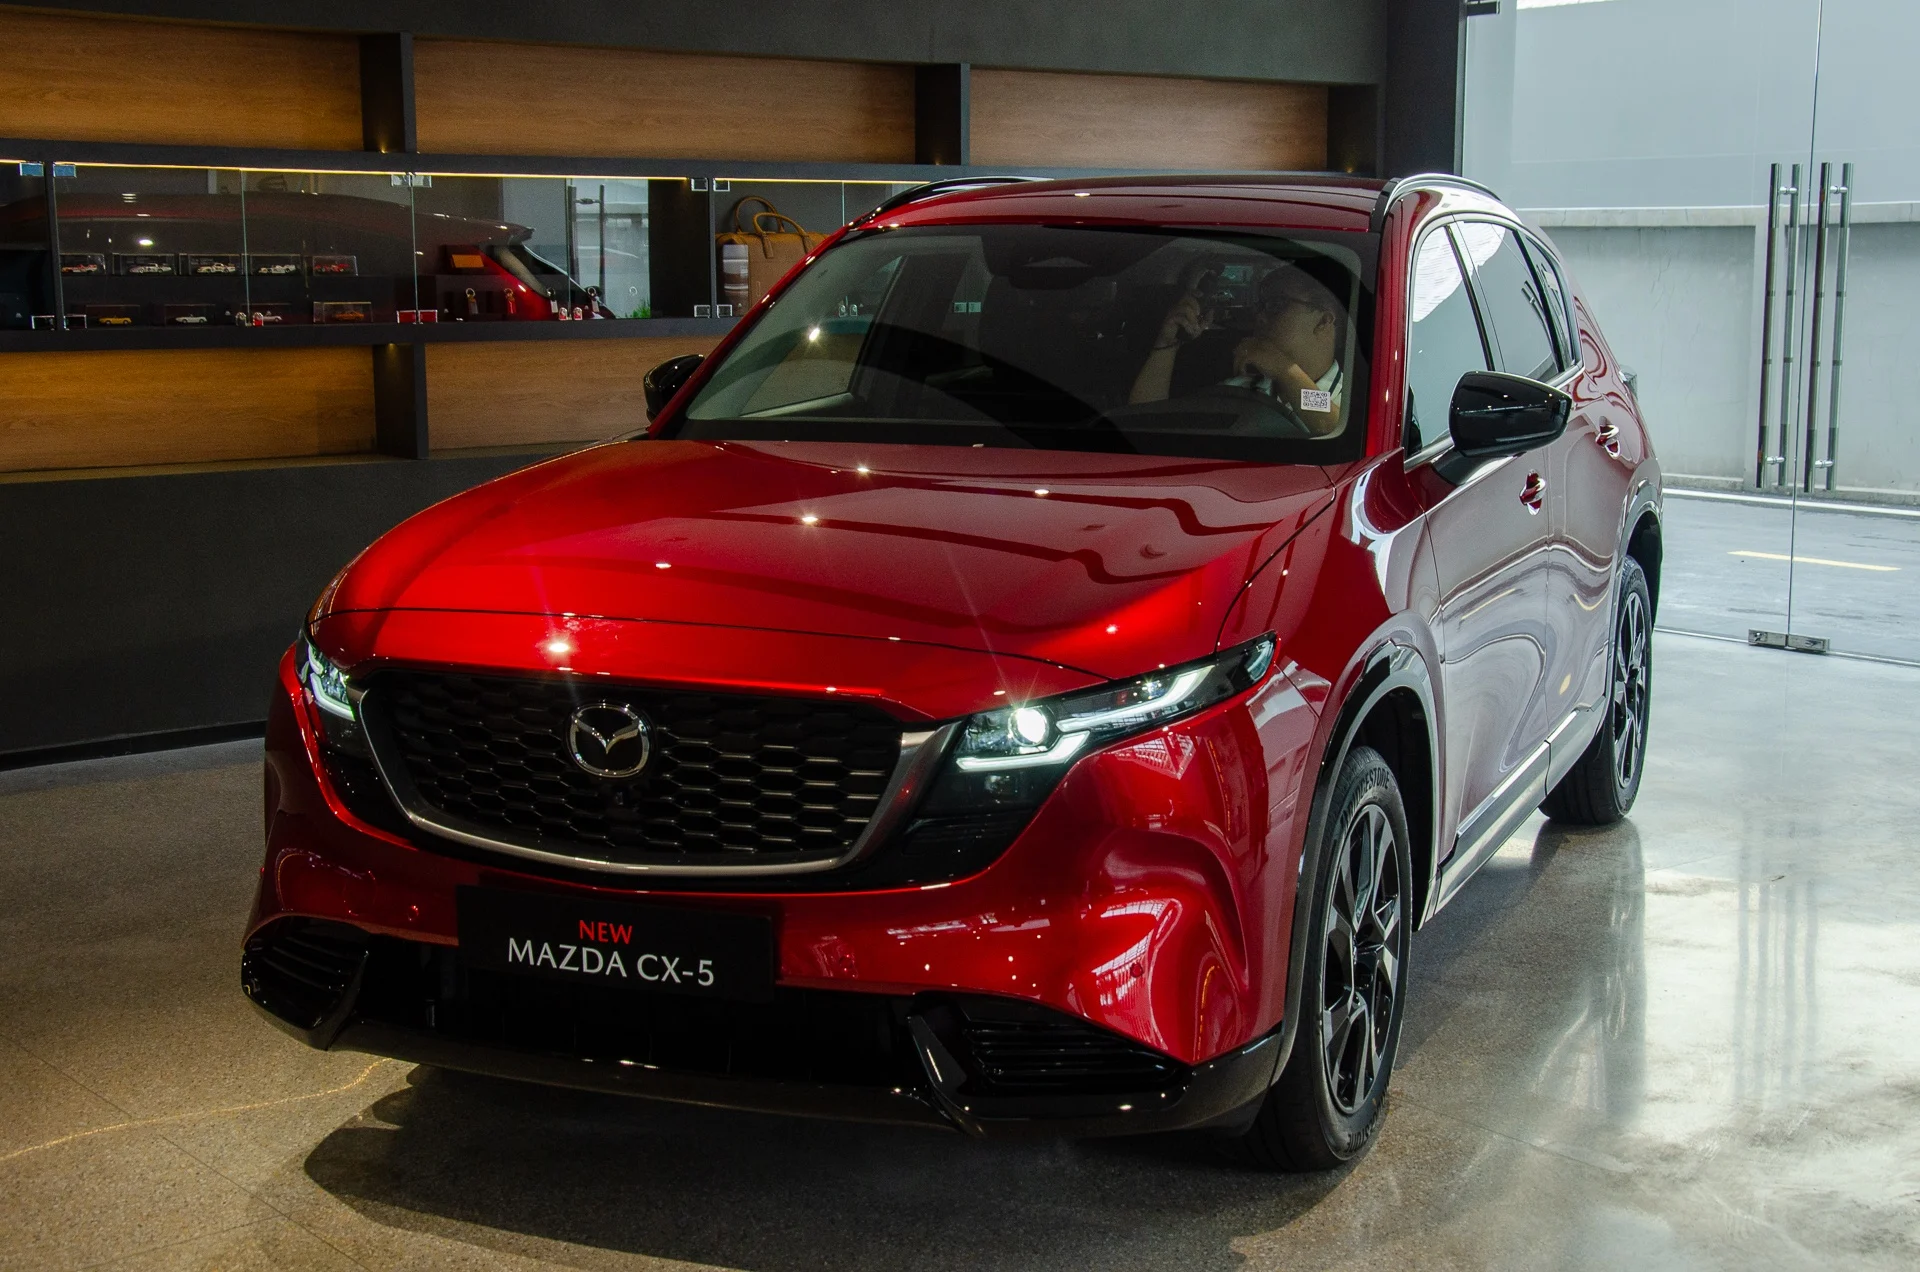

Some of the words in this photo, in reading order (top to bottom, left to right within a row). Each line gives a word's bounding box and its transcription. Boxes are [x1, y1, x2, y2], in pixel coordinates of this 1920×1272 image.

[579, 919, 633, 945] NEW
[508, 937, 627, 978] MAZDA
[637, 953, 714, 986] CX-5
